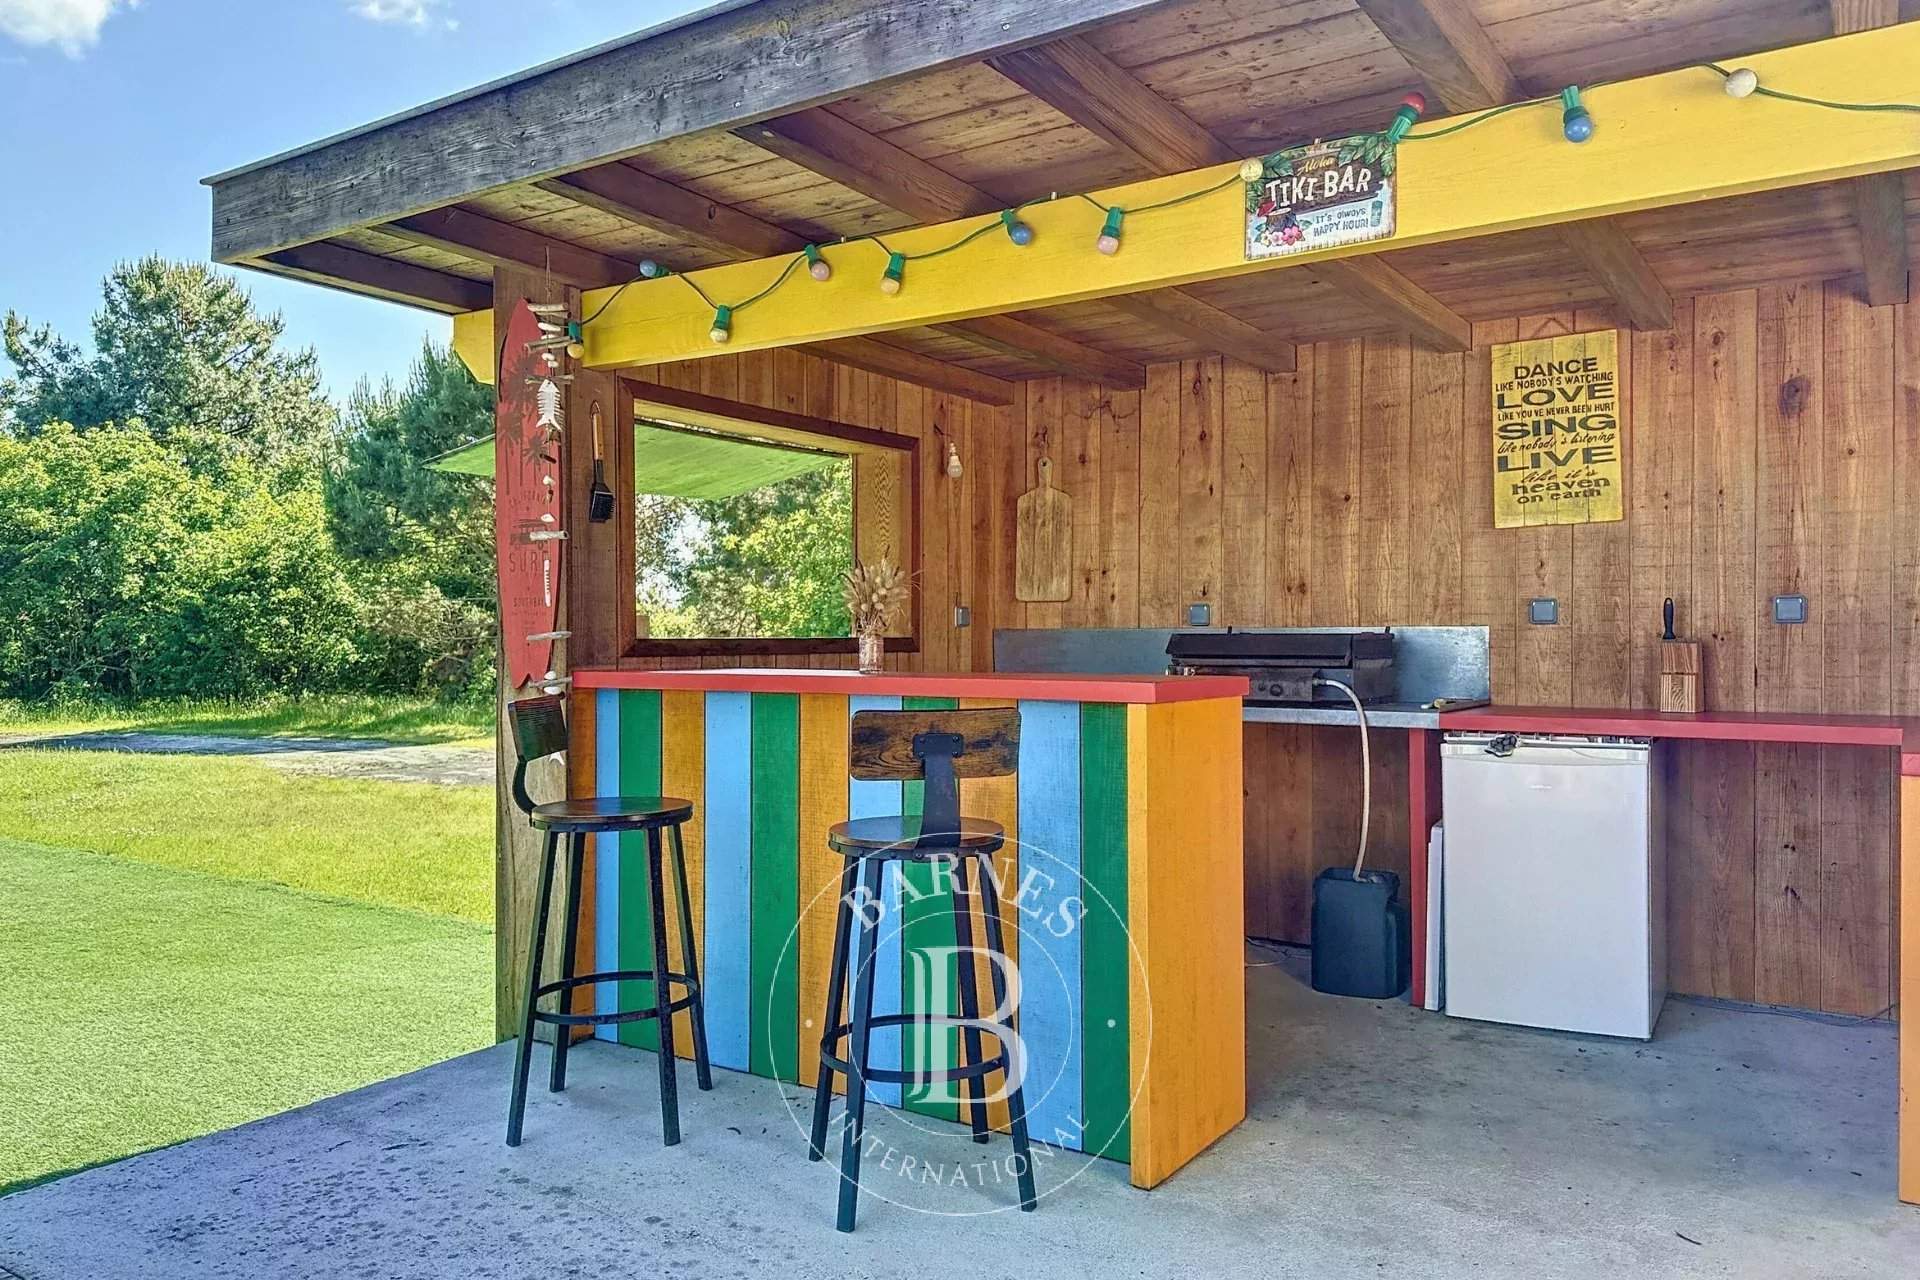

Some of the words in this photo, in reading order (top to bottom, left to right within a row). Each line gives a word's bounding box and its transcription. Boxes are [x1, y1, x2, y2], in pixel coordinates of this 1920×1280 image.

[1297, 155, 1335, 176] Aloha
[1266, 176, 1318, 207] TIKI
[1324, 165, 1371, 198] BAR
[1313, 221, 1341, 237] HAPPY
[1342, 218, 1369, 230] HOUR!
[1514, 357, 1598, 380] DANCE
[1495, 381, 1514, 392] LIKE
[1517, 376, 1562, 389] NOBODY'S
[1565, 372, 1613, 385] WATCHING
[1497, 382, 1615, 409] LOVE
[1497, 411, 1514, 422] LIKE
[1546, 405, 1570, 416] NEVER
[1572, 403, 1592, 414] BEEN
[1594, 402, 1615, 412] HURT
[1497, 413, 1616, 440] SING
[1497, 441, 1519, 454] like
[1570, 432, 1616, 445] listening
[1497, 445, 1616, 472] LIVE
[1511, 477, 1611, 495] heaven
[1521, 469, 1557, 483] like
[1517, 494, 1543, 504] on
[1550, 488, 1602, 500] earth
